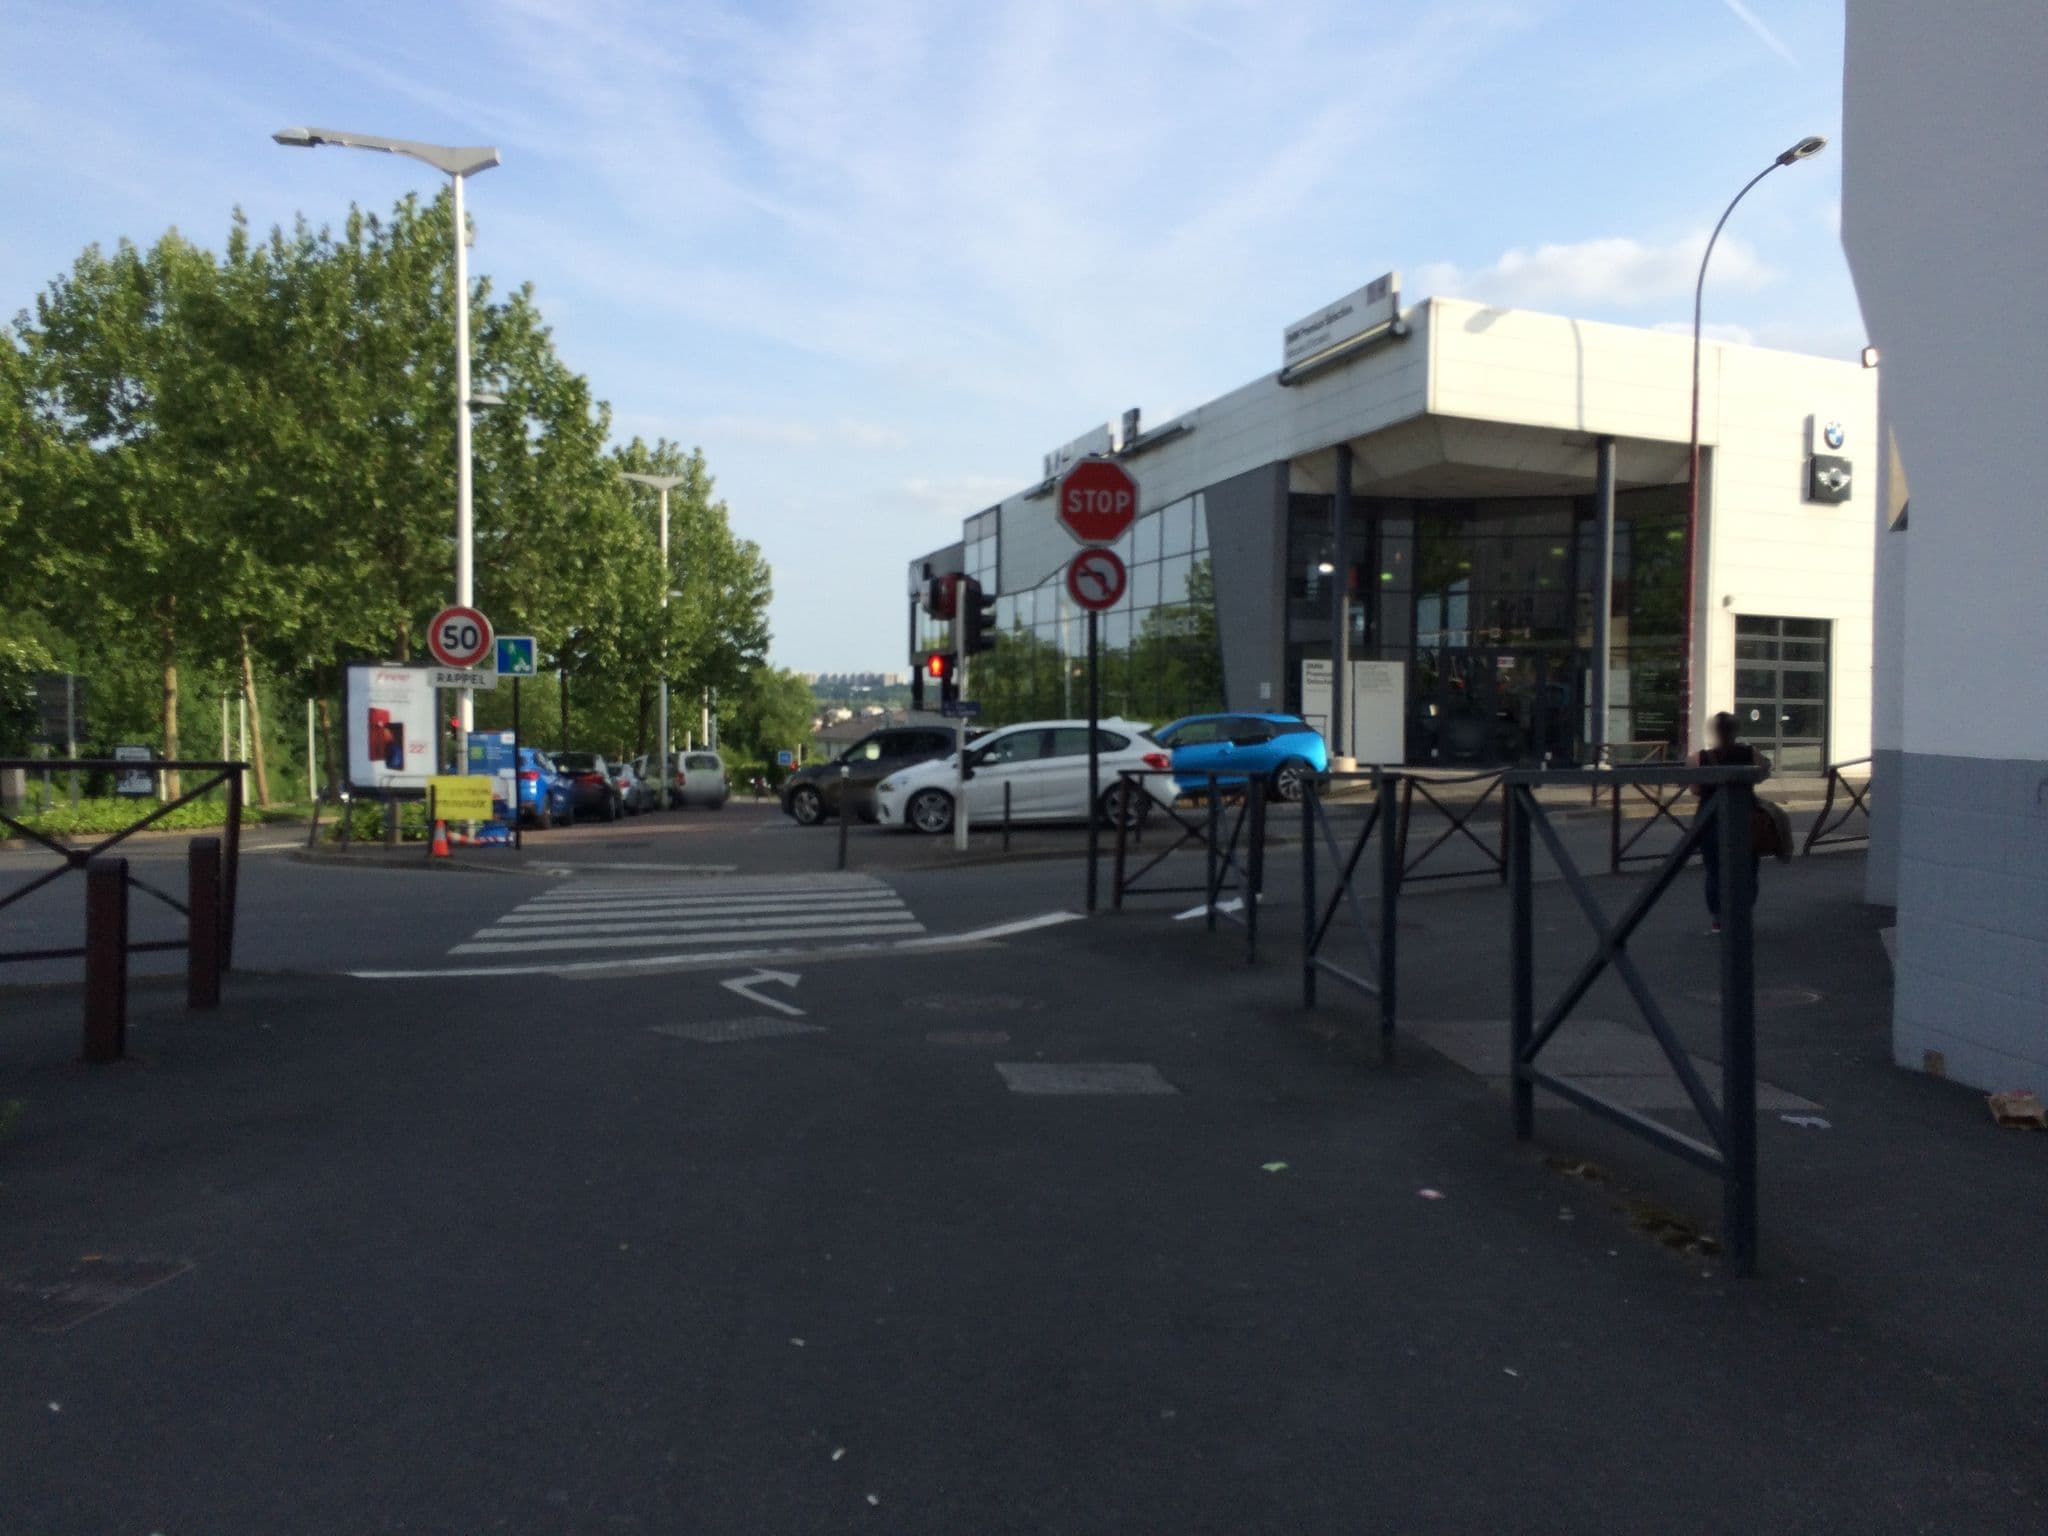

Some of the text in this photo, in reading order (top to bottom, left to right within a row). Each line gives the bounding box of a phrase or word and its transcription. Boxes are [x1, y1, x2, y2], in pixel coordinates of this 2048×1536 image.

[1068, 489, 1130, 513] STOP
[443, 626, 478, 650] 50
[437, 673, 486, 685] RAPPEL
